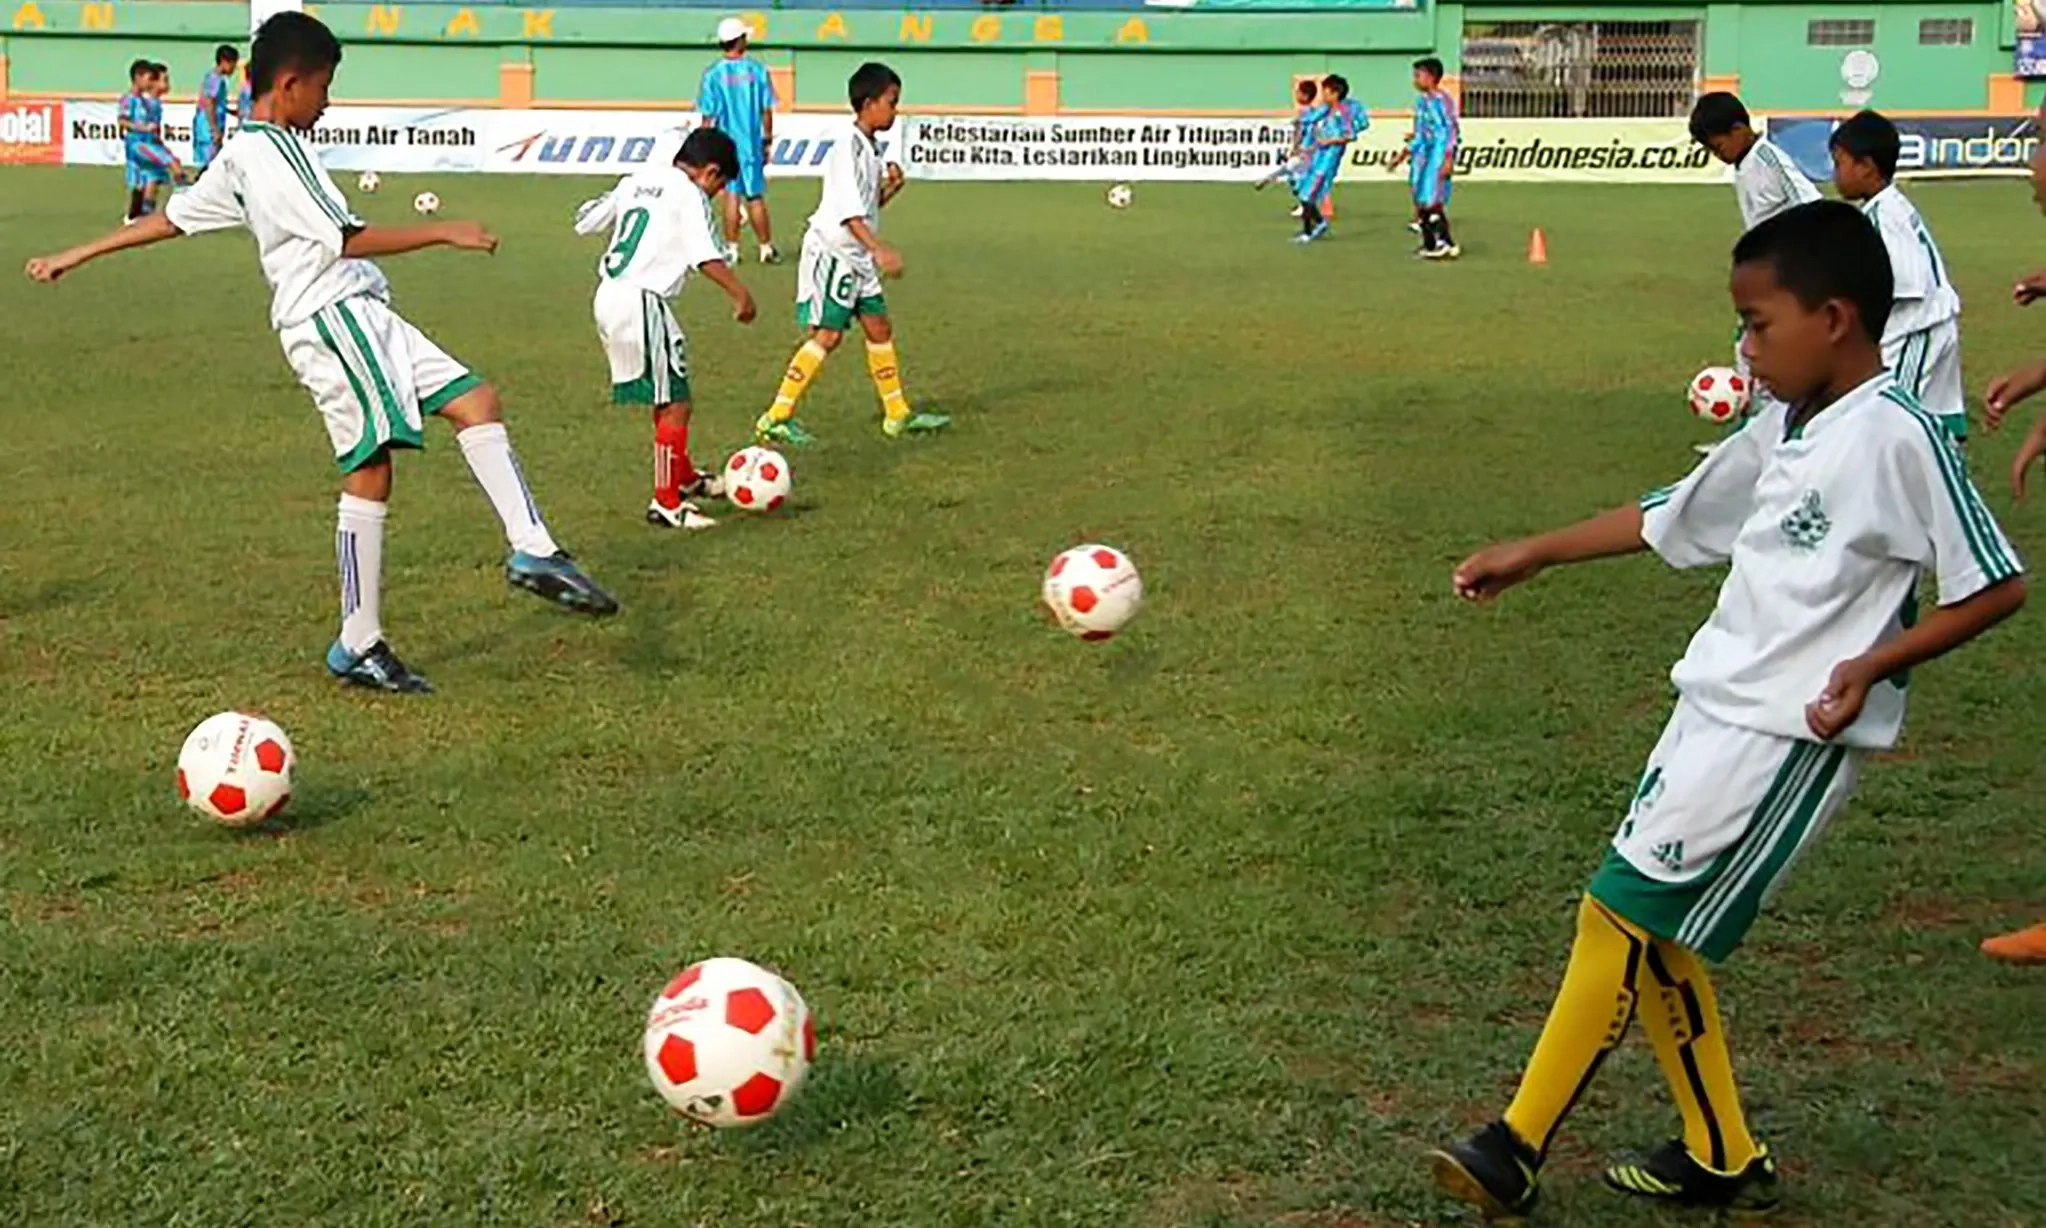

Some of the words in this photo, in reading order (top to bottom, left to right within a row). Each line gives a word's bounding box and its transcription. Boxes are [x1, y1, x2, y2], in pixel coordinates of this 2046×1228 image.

[365, 125, 398, 145] Air
[404, 126, 476, 146] Tanah
[919, 124, 1046, 143] Kelestarian
[1051, 124, 1136, 143] Sumber
[1140, 125, 1172, 143] Air
[1176, 125, 1253, 146] Titipan
[910, 144, 966, 164] Cucu
[1022, 147, 1138, 166] Lestarikan
[1142, 148, 1271, 168] Lingkungan
[604, 206, 651, 279] 9
